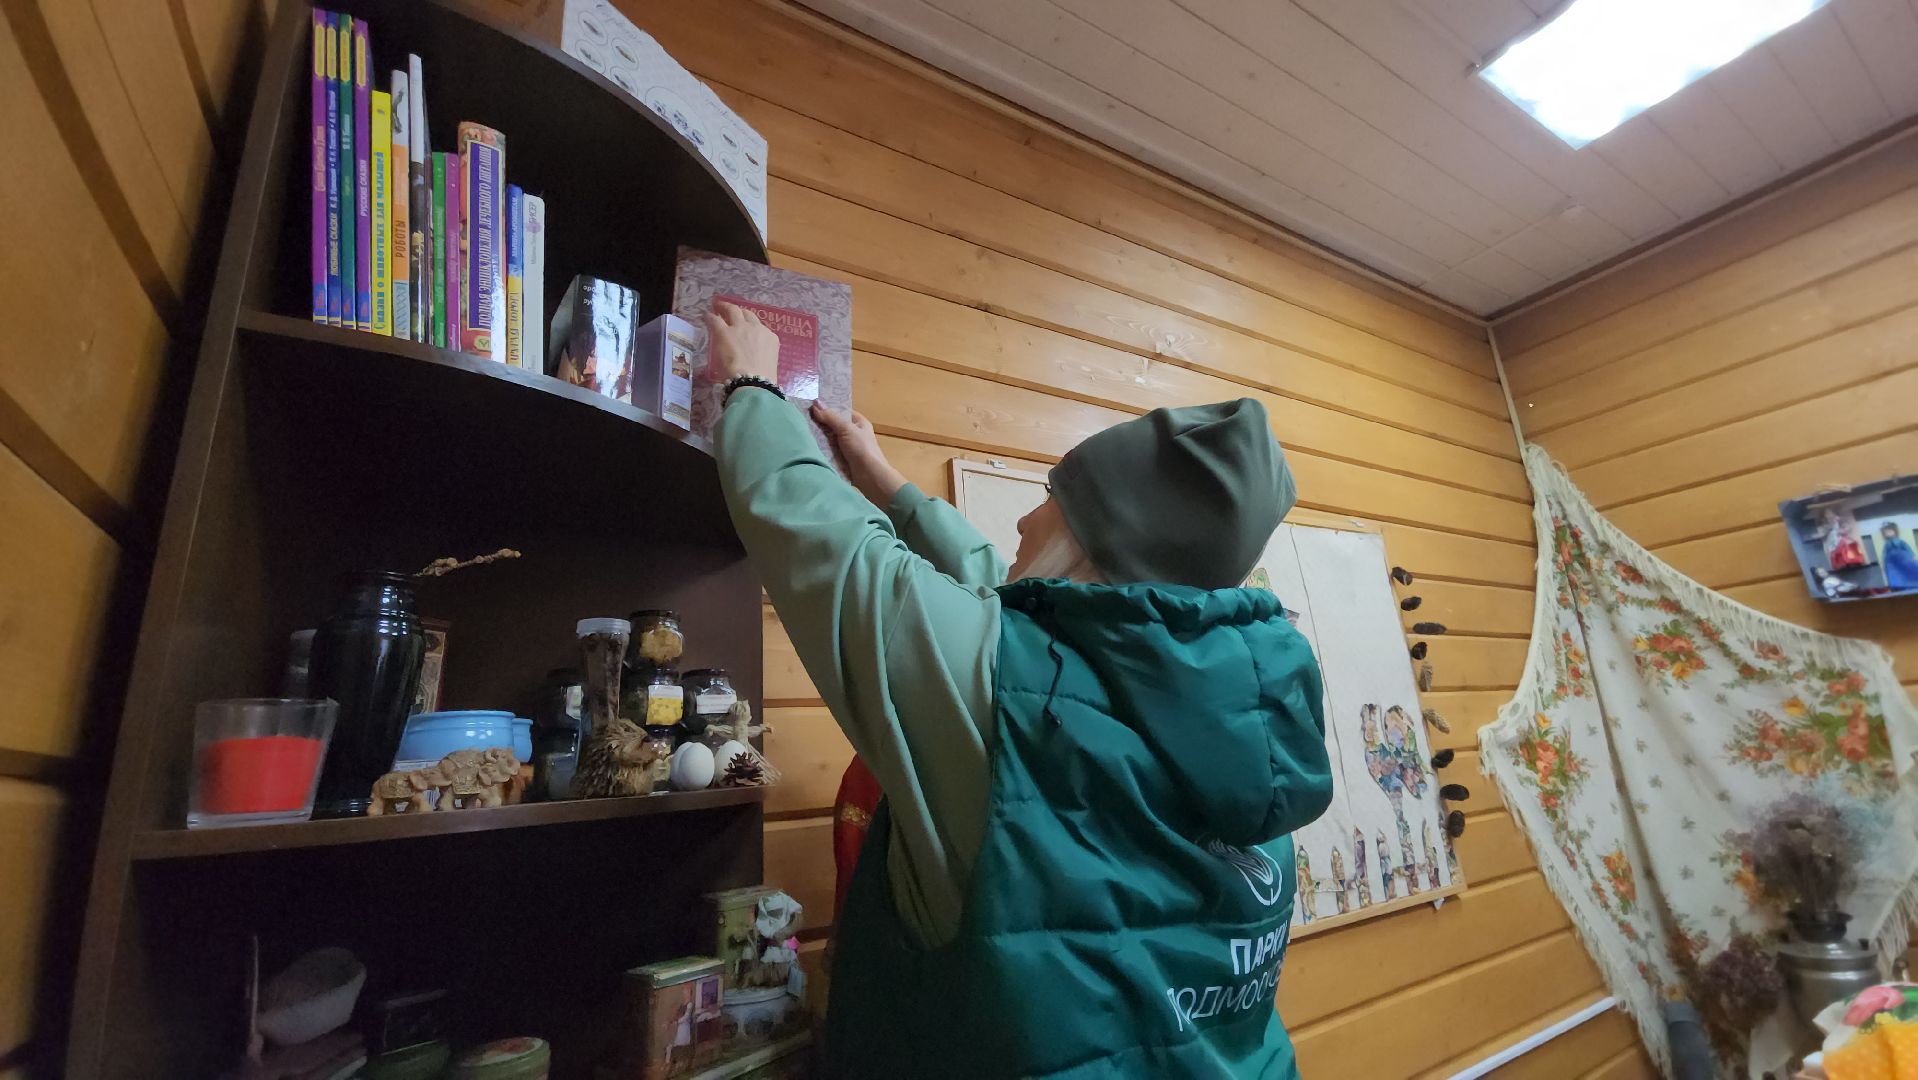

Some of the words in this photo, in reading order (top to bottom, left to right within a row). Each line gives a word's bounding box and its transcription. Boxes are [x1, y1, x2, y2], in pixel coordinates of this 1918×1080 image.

[360, 159, 368, 186] СКАЗКИ
[374, 151, 385, 199] малышей
[478, 145, 492, 183] ПИТАНИЯ
[360, 187, 368, 216] РУССКИЕ
[478, 183, 492, 228] ЛЕЧЕБНОГО
[528, 202, 537, 224] БИСЕР
[376, 222, 386, 278] животных
[394, 220, 406, 258] РОБОТЫ
[478, 228, 492, 292] ЭНЦИКЛОПЕДИЯ
[374, 292, 386, 330] Сказки
[478, 293, 492, 327] ПОЛНАЯ
